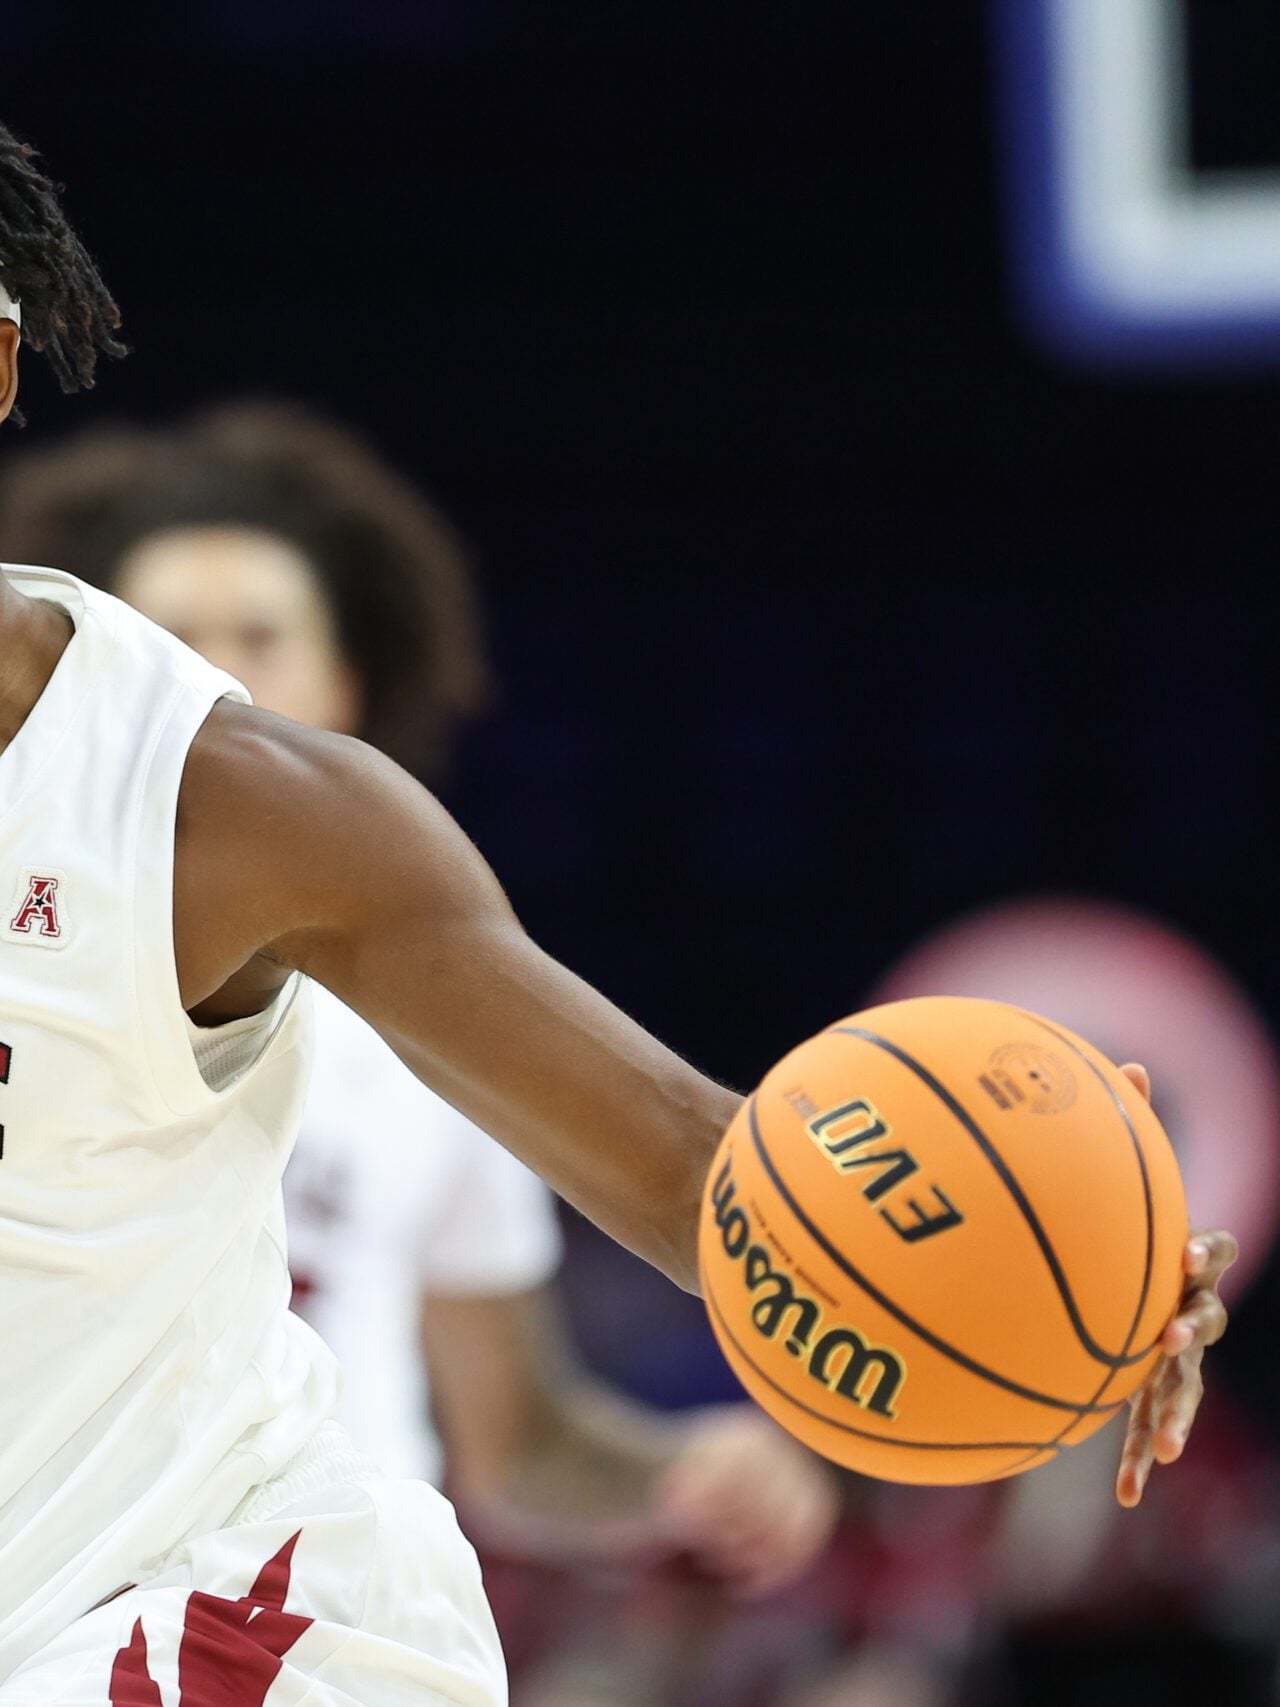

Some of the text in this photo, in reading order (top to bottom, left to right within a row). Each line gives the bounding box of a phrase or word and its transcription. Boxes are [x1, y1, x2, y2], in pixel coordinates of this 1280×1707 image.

[10, 875, 61, 937] A
[806, 1097, 964, 1244] EVO
[711, 1146, 907, 1420] Wilson
